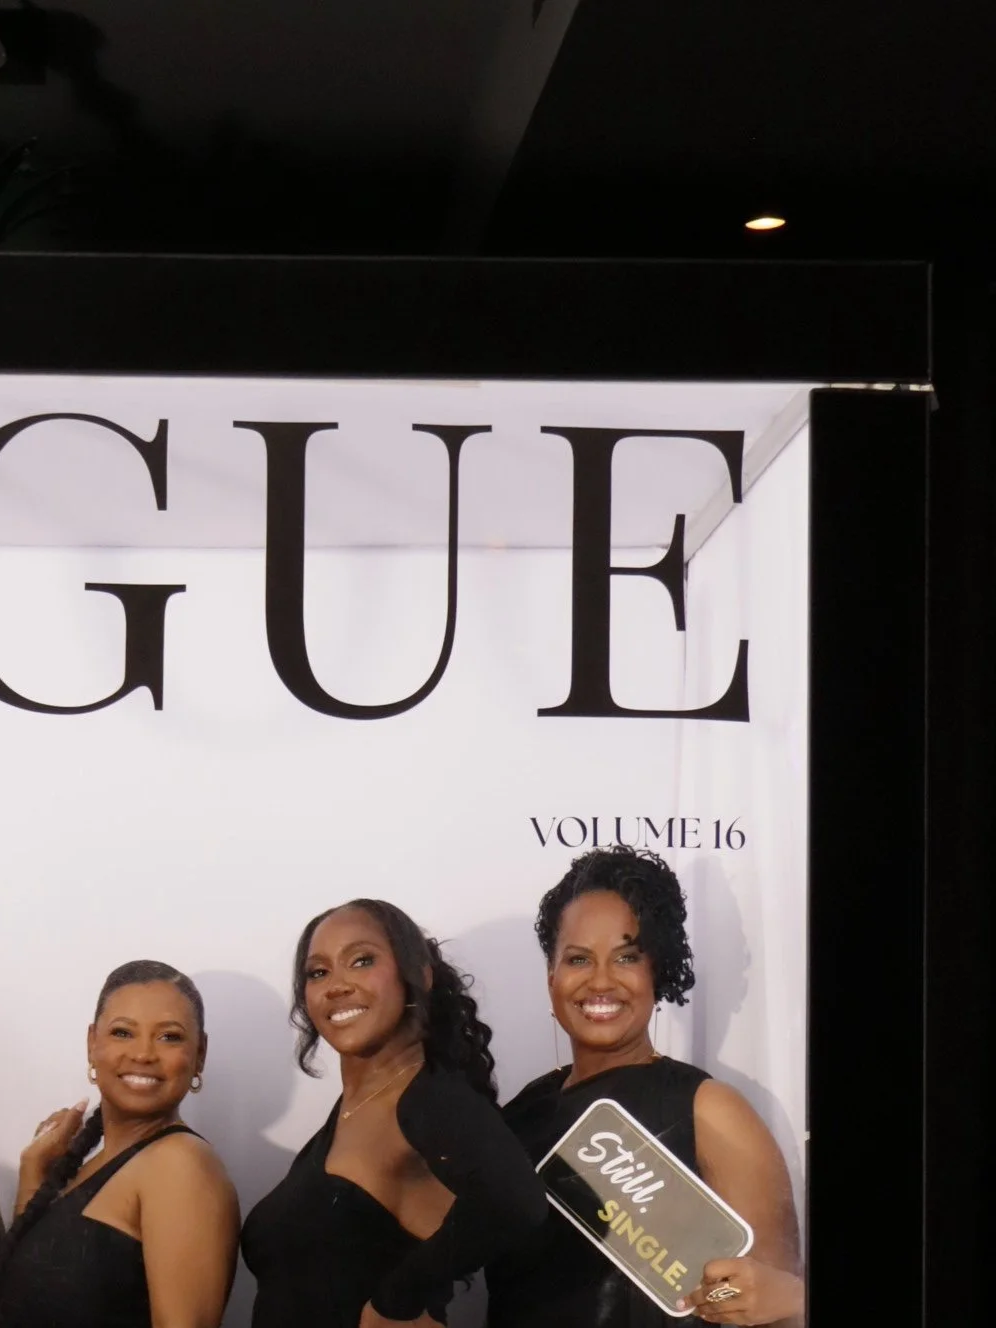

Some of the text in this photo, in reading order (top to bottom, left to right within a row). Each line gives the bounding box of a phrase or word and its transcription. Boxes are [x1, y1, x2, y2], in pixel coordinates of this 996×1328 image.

[529, 816, 747, 851] VOLUME 16
[596, 1199, 688, 1292] SINGLE.
